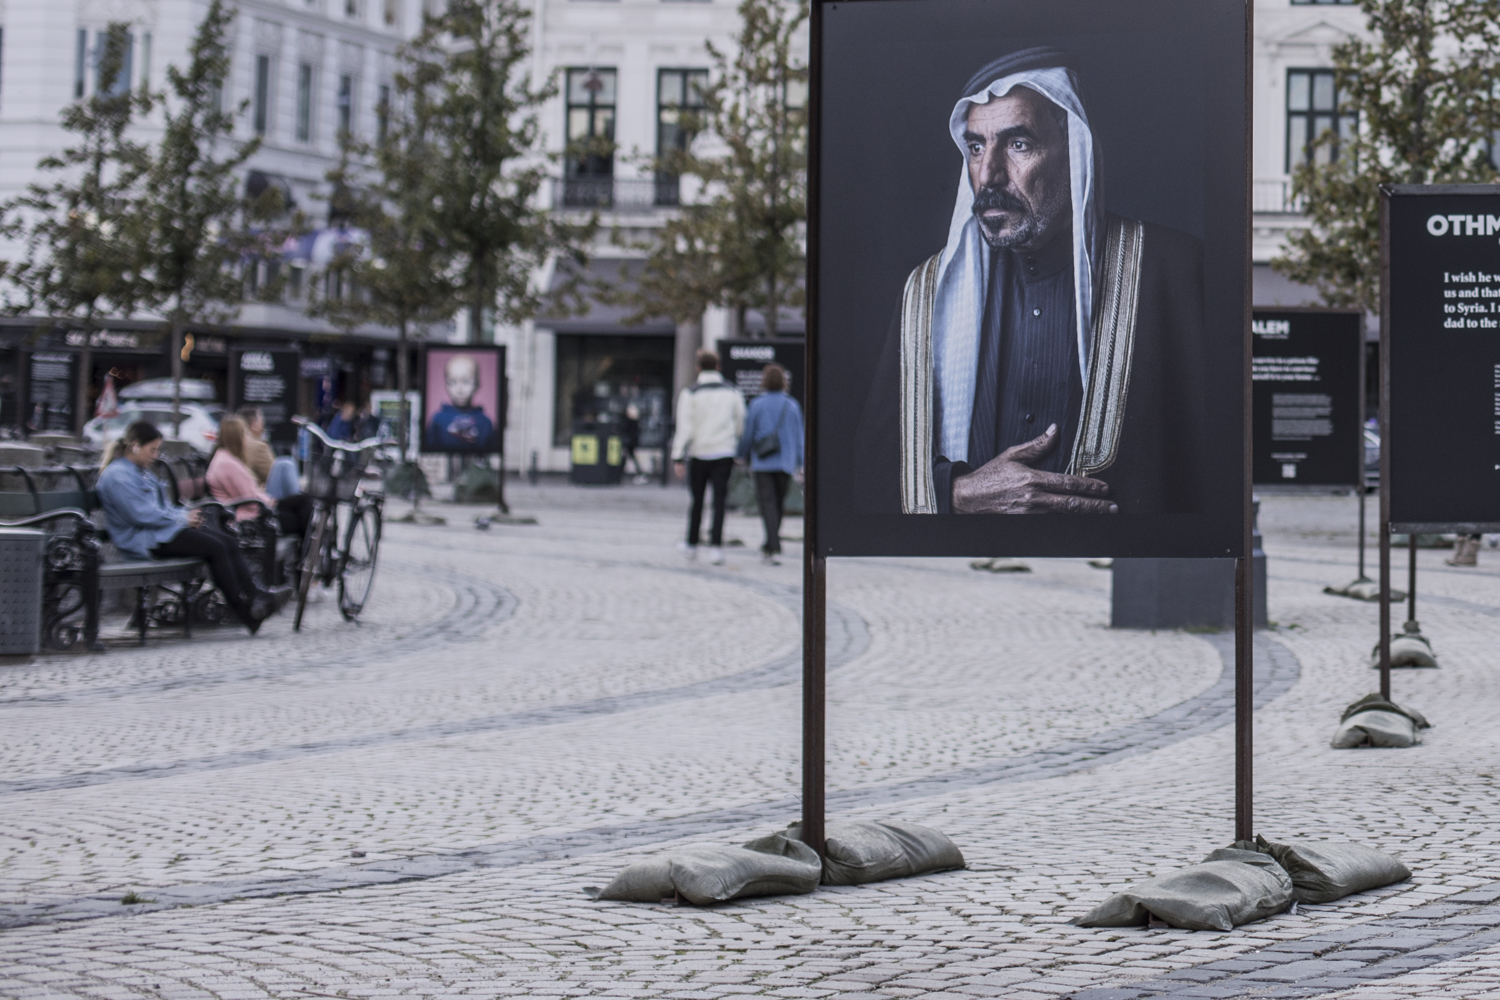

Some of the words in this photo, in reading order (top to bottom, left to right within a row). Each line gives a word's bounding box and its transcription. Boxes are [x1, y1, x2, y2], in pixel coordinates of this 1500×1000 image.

[1444, 272, 1449, 283] I
[1451, 271, 1476, 283] wish
[1478, 271, 1492, 283] he
[1444, 289, 1457, 298] us
[1458, 286, 1479, 298] and
[1444, 303, 1456, 313] to
[1457, 302, 1488, 316] Syria.
[1490, 302, 1496, 313] I
[1443, 317, 1465, 328] dad
[1466, 318, 1478, 328] to
[1480, 317, 1498, 328] the
